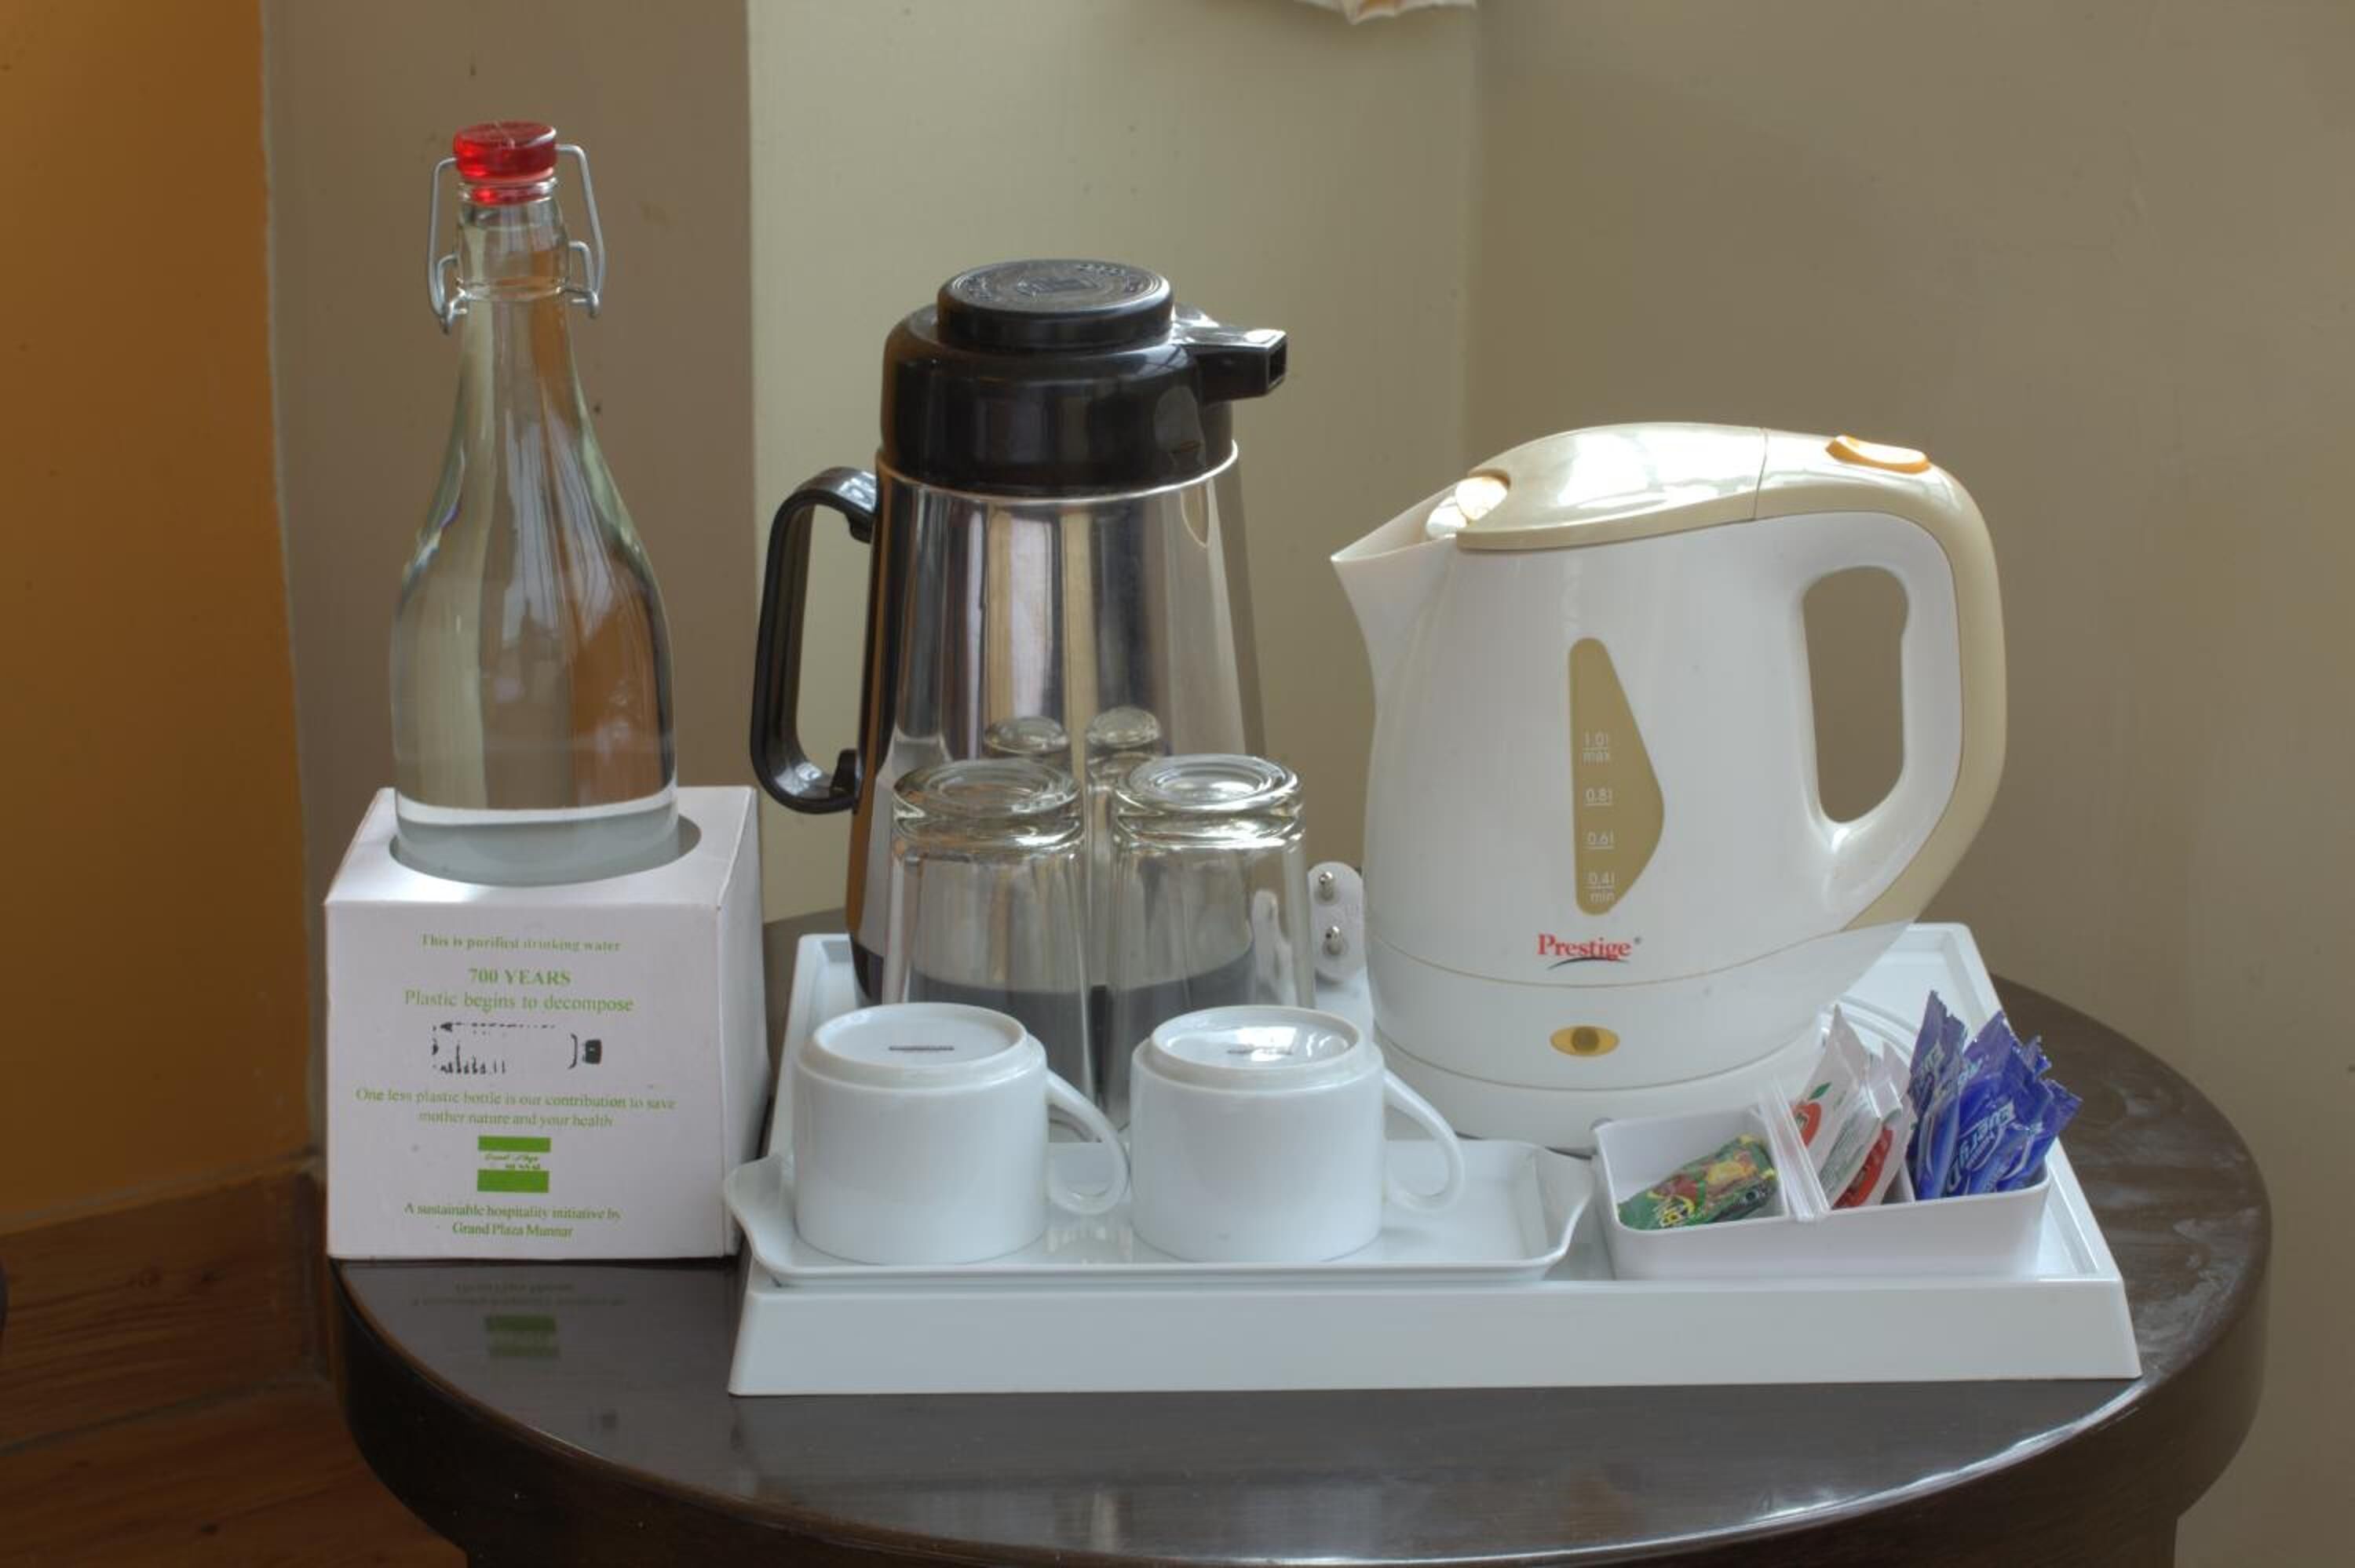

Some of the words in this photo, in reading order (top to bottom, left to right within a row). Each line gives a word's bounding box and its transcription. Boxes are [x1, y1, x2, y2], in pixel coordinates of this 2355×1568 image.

[422, 934, 448, 947] This
[466, 935, 519, 951] purified
[524, 937, 579, 953] drinking
[583, 940, 621, 953] water
[1537, 933, 1632, 961] Prestige
[468, 968, 498, 984] 700
[505, 969, 571, 986] YEARS
[405, 990, 457, 1007] Plastic
[464, 991, 516, 1013] begins
[544, 994, 634, 1014] decompose
[356, 1088, 385, 1101] One
[416, 1090, 459, 1105] plastic
[464, 1090, 502, 1104] bottle
[519, 1095, 542, 1106] our
[545, 1093, 627, 1108] contribution
[646, 1099, 677, 1110] save
[418, 1110, 466, 1124] mother
[469, 1113, 511, 1125] nature
[513, 1113, 537, 1125] and
[539, 1116, 568, 1129] your
[572, 1114, 614, 1128] health
[417, 1204, 485, 1217] sustainable
[487, 1205, 547, 1220] hospitality
[552, 1206, 604, 1220] initiative
[452, 1222, 490, 1235] Grand
[491, 1223, 524, 1237] Plaza
[526, 1225, 575, 1238] Munnar
